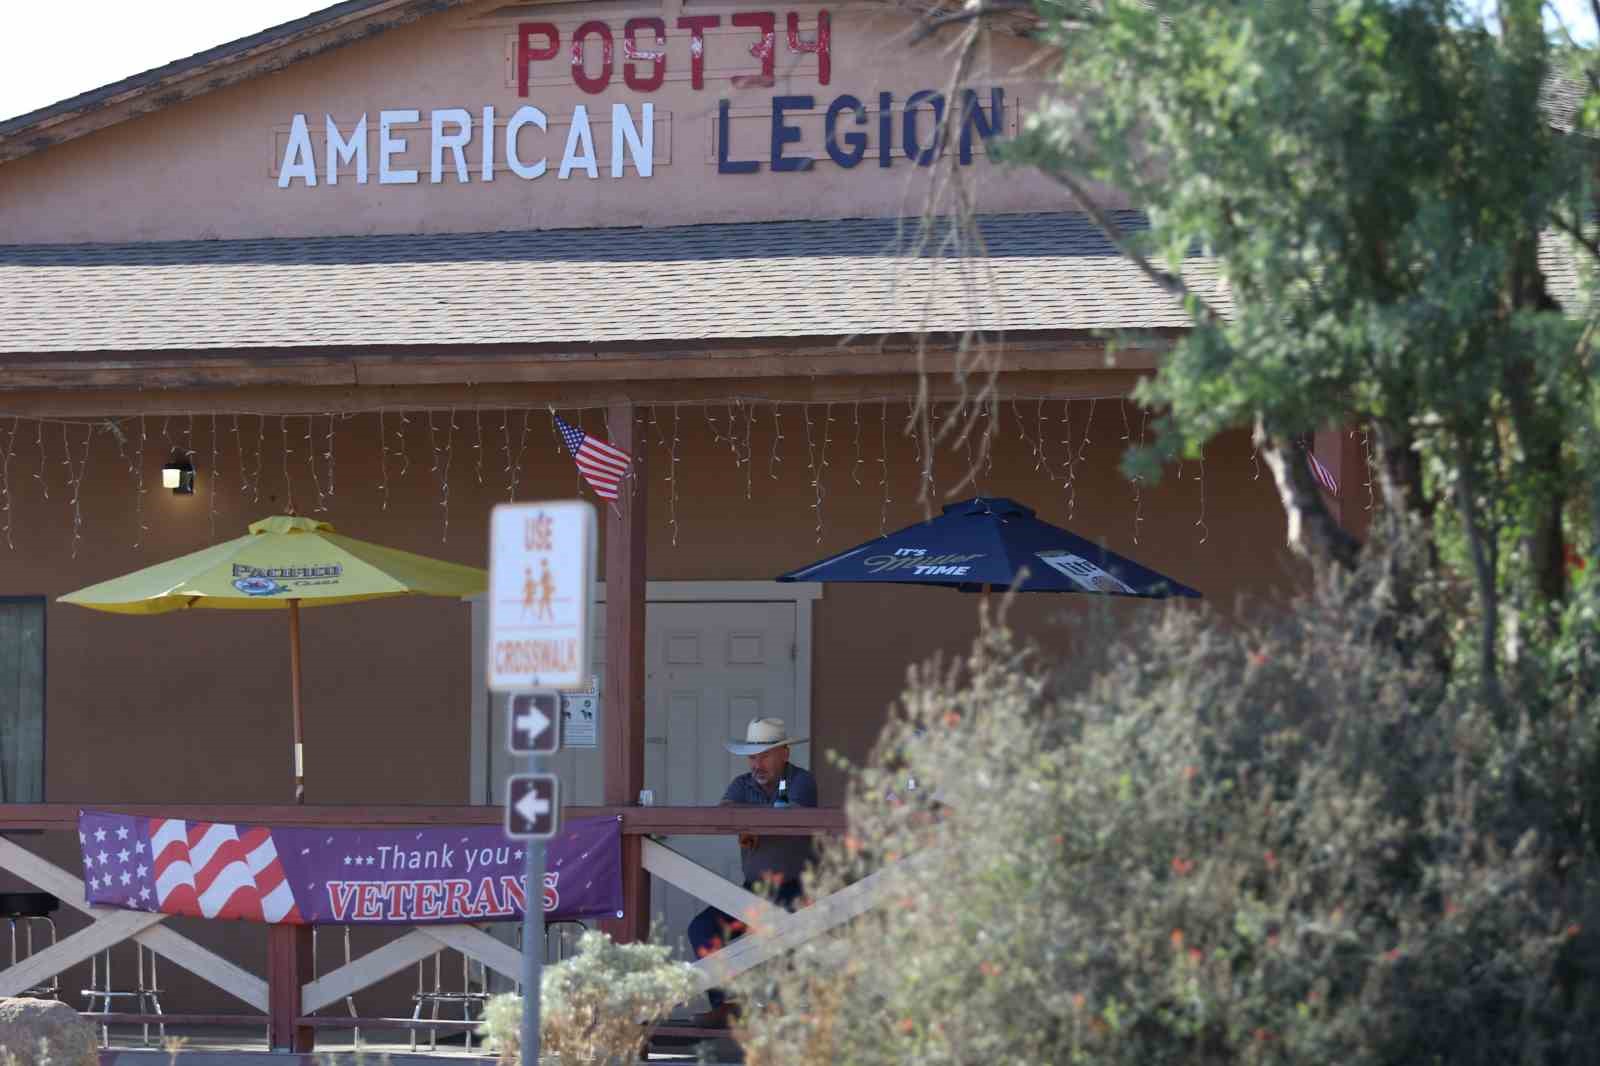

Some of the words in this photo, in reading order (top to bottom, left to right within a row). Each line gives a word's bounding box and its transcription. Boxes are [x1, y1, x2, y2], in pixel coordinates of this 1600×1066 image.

[277, 102, 654, 189] AMERICAN
[717, 86, 1006, 174] LEGION
[525, 517, 553, 552] USE
[894, 547, 928, 556] IT'S
[912, 565, 971, 576] TIME
[496, 640, 577, 674] CROSSWALK
[377, 845, 454, 870] Thank
[465, 846, 509, 872] you
[326, 872, 560, 921] VETERANS
